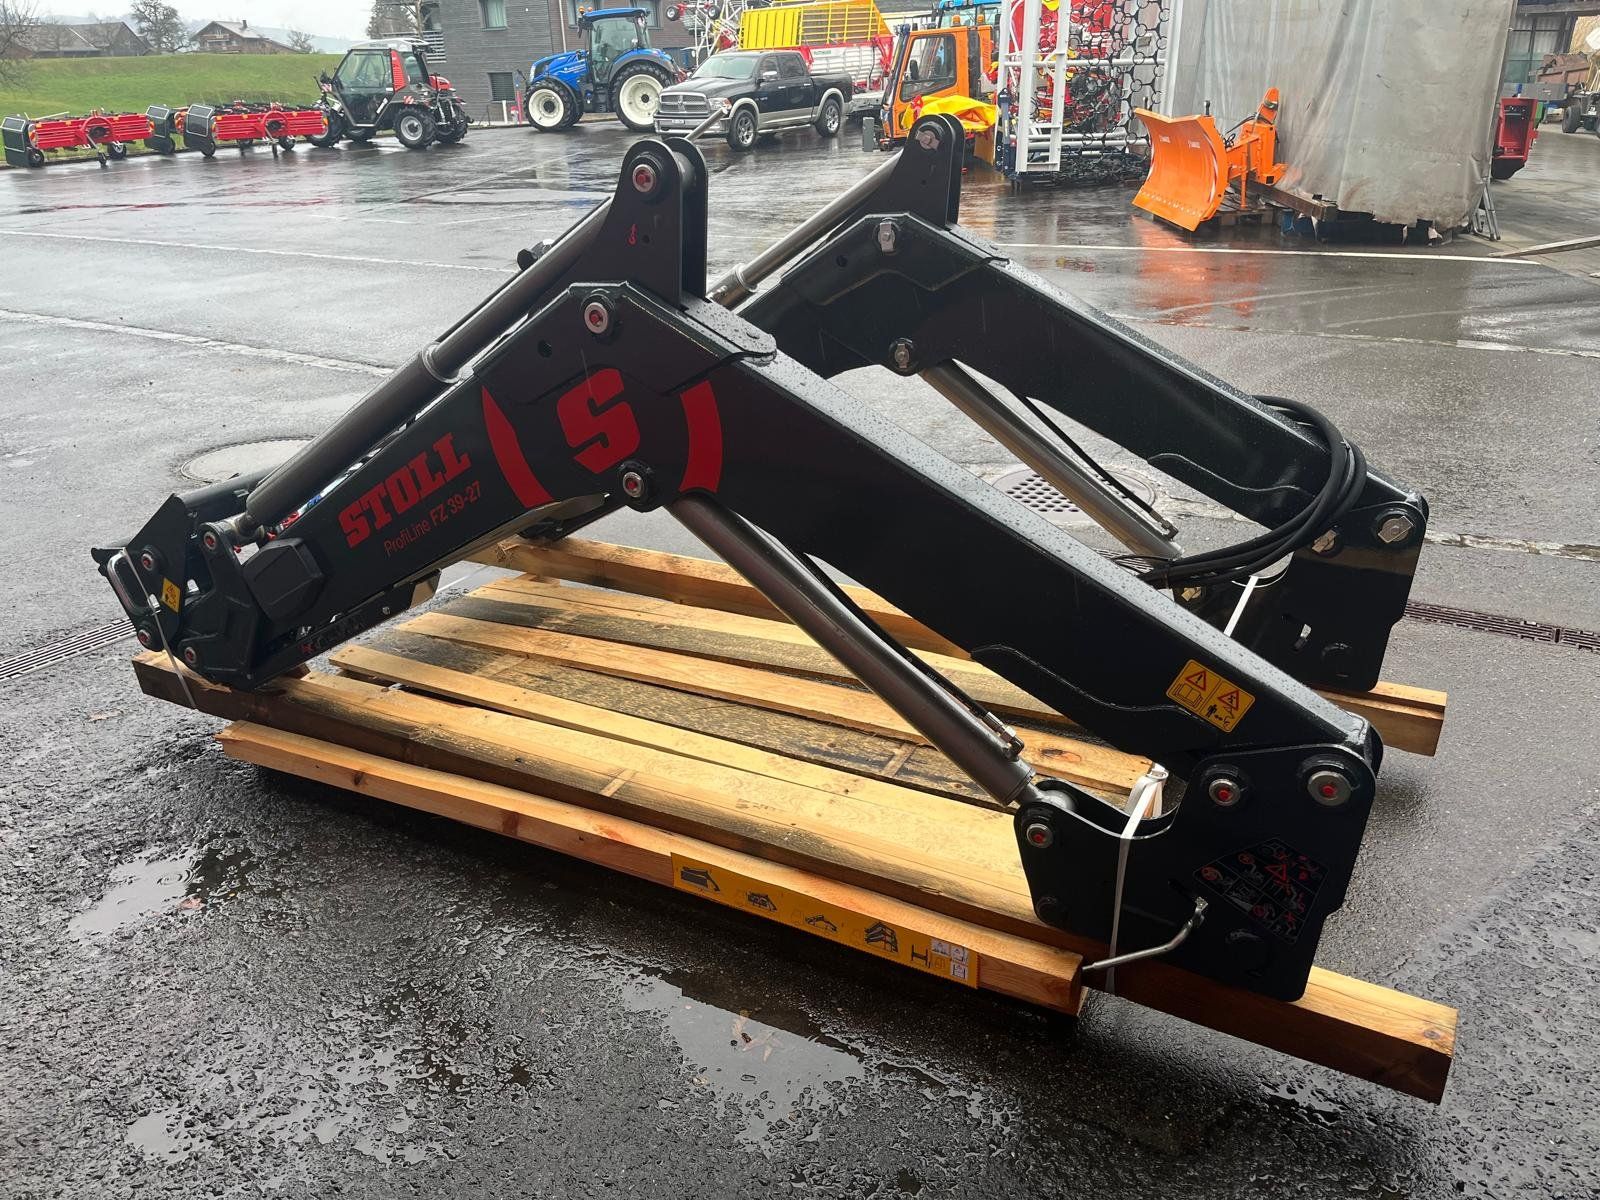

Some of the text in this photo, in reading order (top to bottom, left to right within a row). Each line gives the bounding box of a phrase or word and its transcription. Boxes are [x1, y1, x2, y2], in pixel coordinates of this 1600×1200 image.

[557, 368, 641, 474] S
[338, 432, 472, 548] STOLL
[384, 480, 481, 558] ProfiLine FZ 39-27
